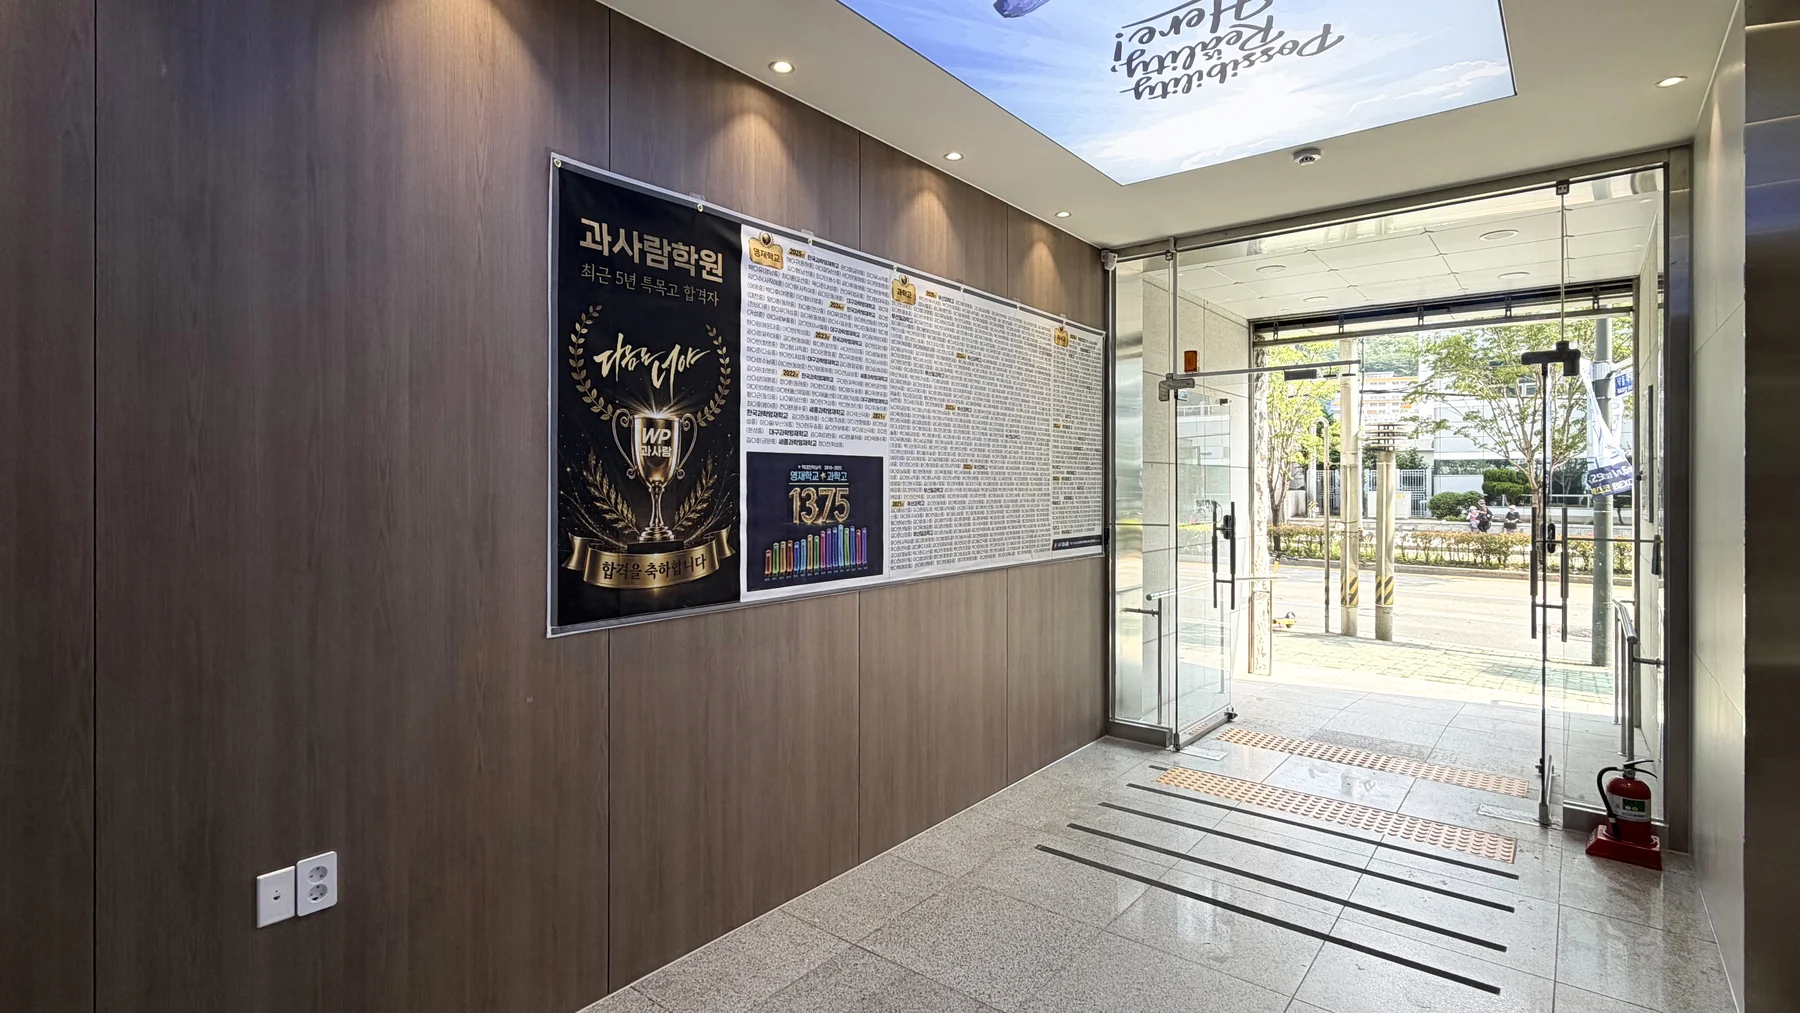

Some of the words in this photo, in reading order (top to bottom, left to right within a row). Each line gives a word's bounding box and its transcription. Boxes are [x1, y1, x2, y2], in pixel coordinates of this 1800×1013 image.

[1119, 23, 1345, 100] Possibility
[1204, 49, 1222, 61] is
[579, 217, 724, 284] 과사람학원
[753, 247, 781, 263] 영재학교
[581, 263, 612, 285] 최근
[615, 271, 636, 290] 5년
[640, 276, 680, 298] 특목고
[683, 284, 720, 307] 합격자
[896, 287, 912, 299] 과학고
[746, 408, 788, 419] 한국과학영재학교
[642, 427, 672, 444] WP
[768, 428, 808, 438] 대구과학영재학교
[640, 445, 672, 458] 과사람
[790, 470, 819, 481] 영재학교
[826, 471, 848, 481] 과학고
[788, 487, 851, 524] 1375
[601, 561, 642, 580] 합격을
[644, 553, 707, 580] 축하합니다
